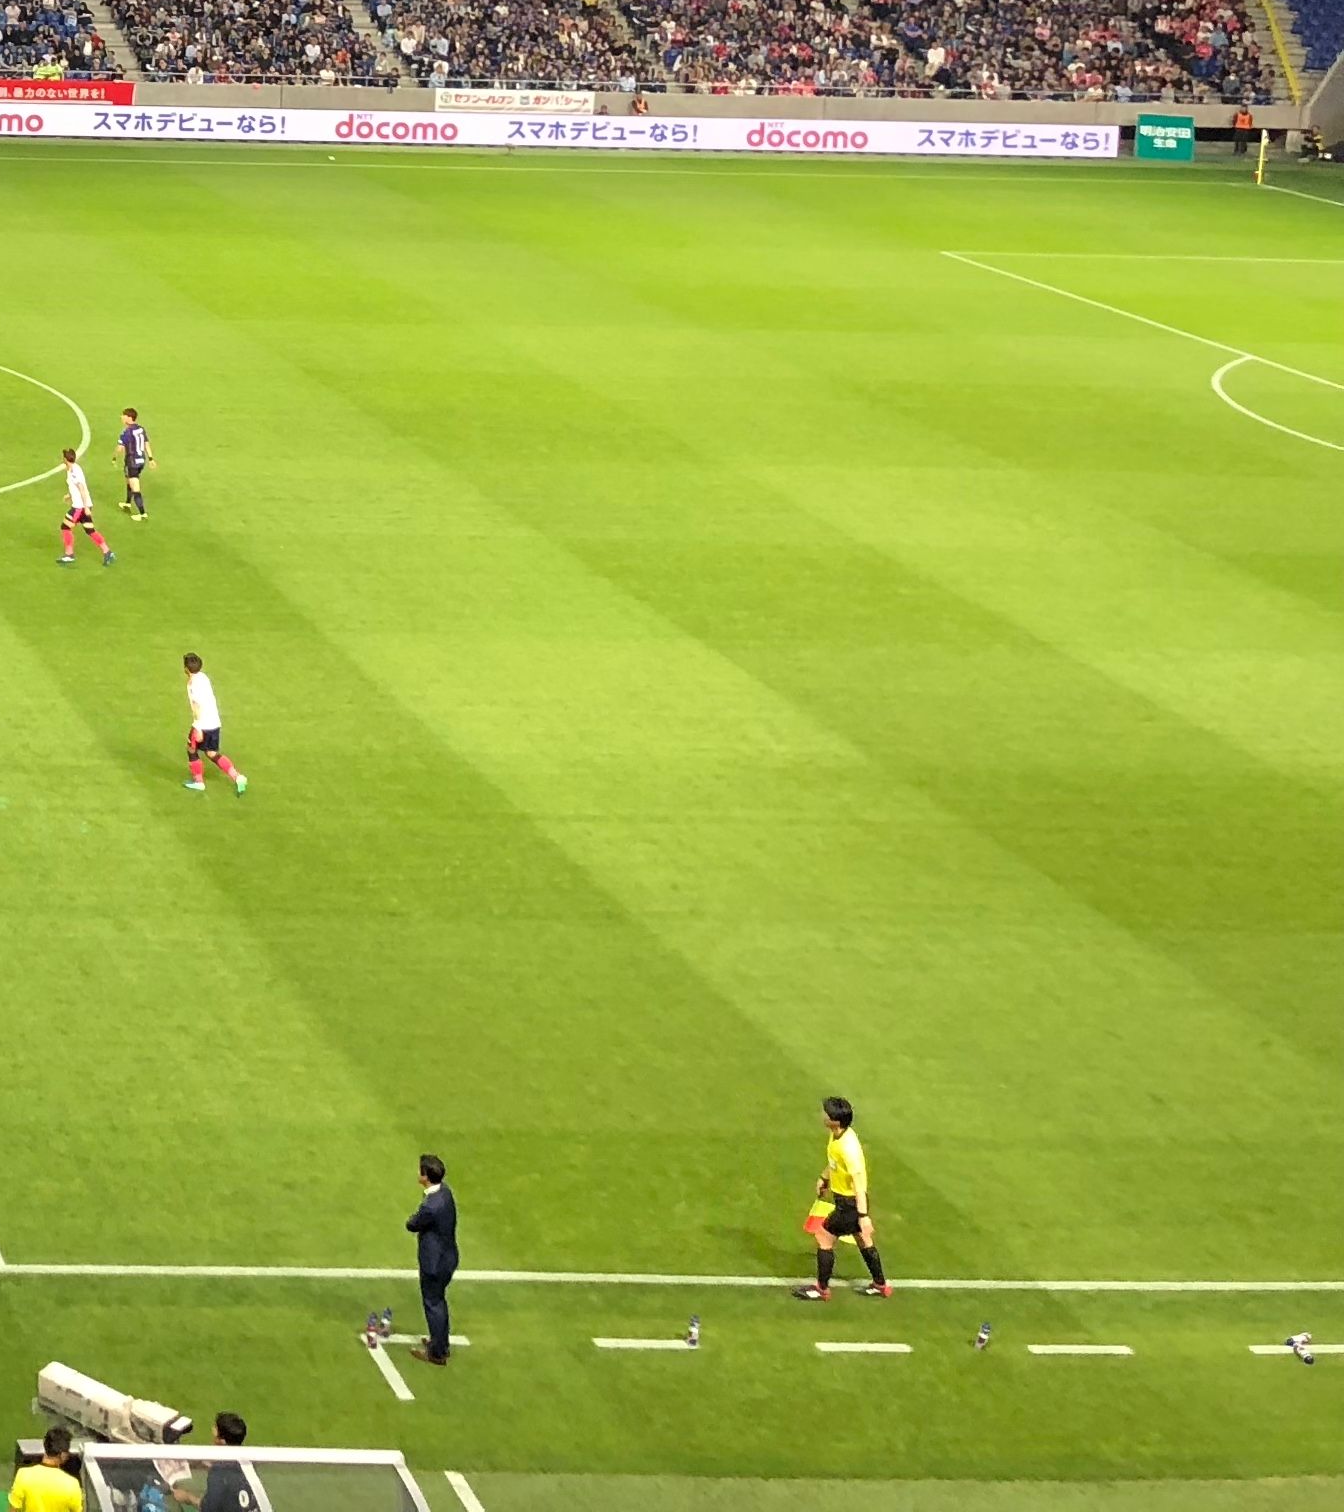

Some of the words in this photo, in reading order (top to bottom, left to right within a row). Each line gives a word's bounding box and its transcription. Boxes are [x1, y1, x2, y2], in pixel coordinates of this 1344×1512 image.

[93, 112, 285, 134] スマホデビューなら!
[335, 114, 458, 140] docomo
[507, 121, 698, 143] スマホデビューなら!
[747, 123, 868, 149] docomo
[916, 129, 1109, 150] スマホデビューなら!
